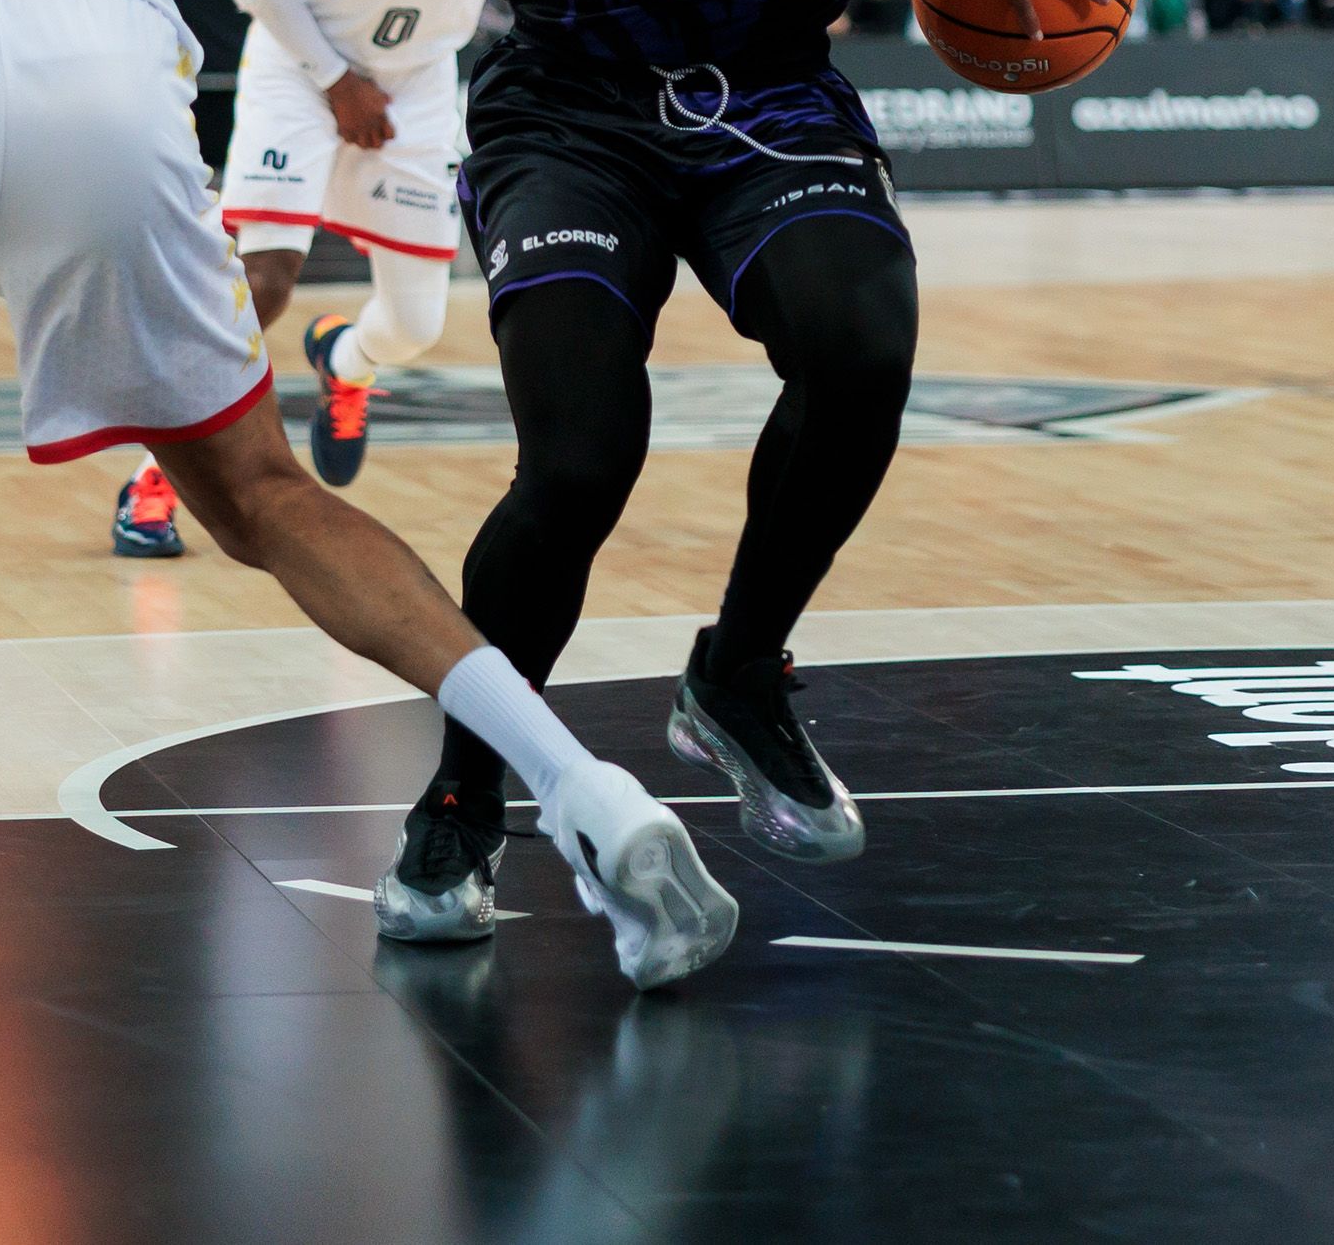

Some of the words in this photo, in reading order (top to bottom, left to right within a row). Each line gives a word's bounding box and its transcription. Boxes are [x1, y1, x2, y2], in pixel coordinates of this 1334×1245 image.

[372, 7, 421, 49] 0
[1071, 87, 1321, 132] azulmarino
[522, 236, 544, 252] EL
[546, 229, 615, 252] CORREO
